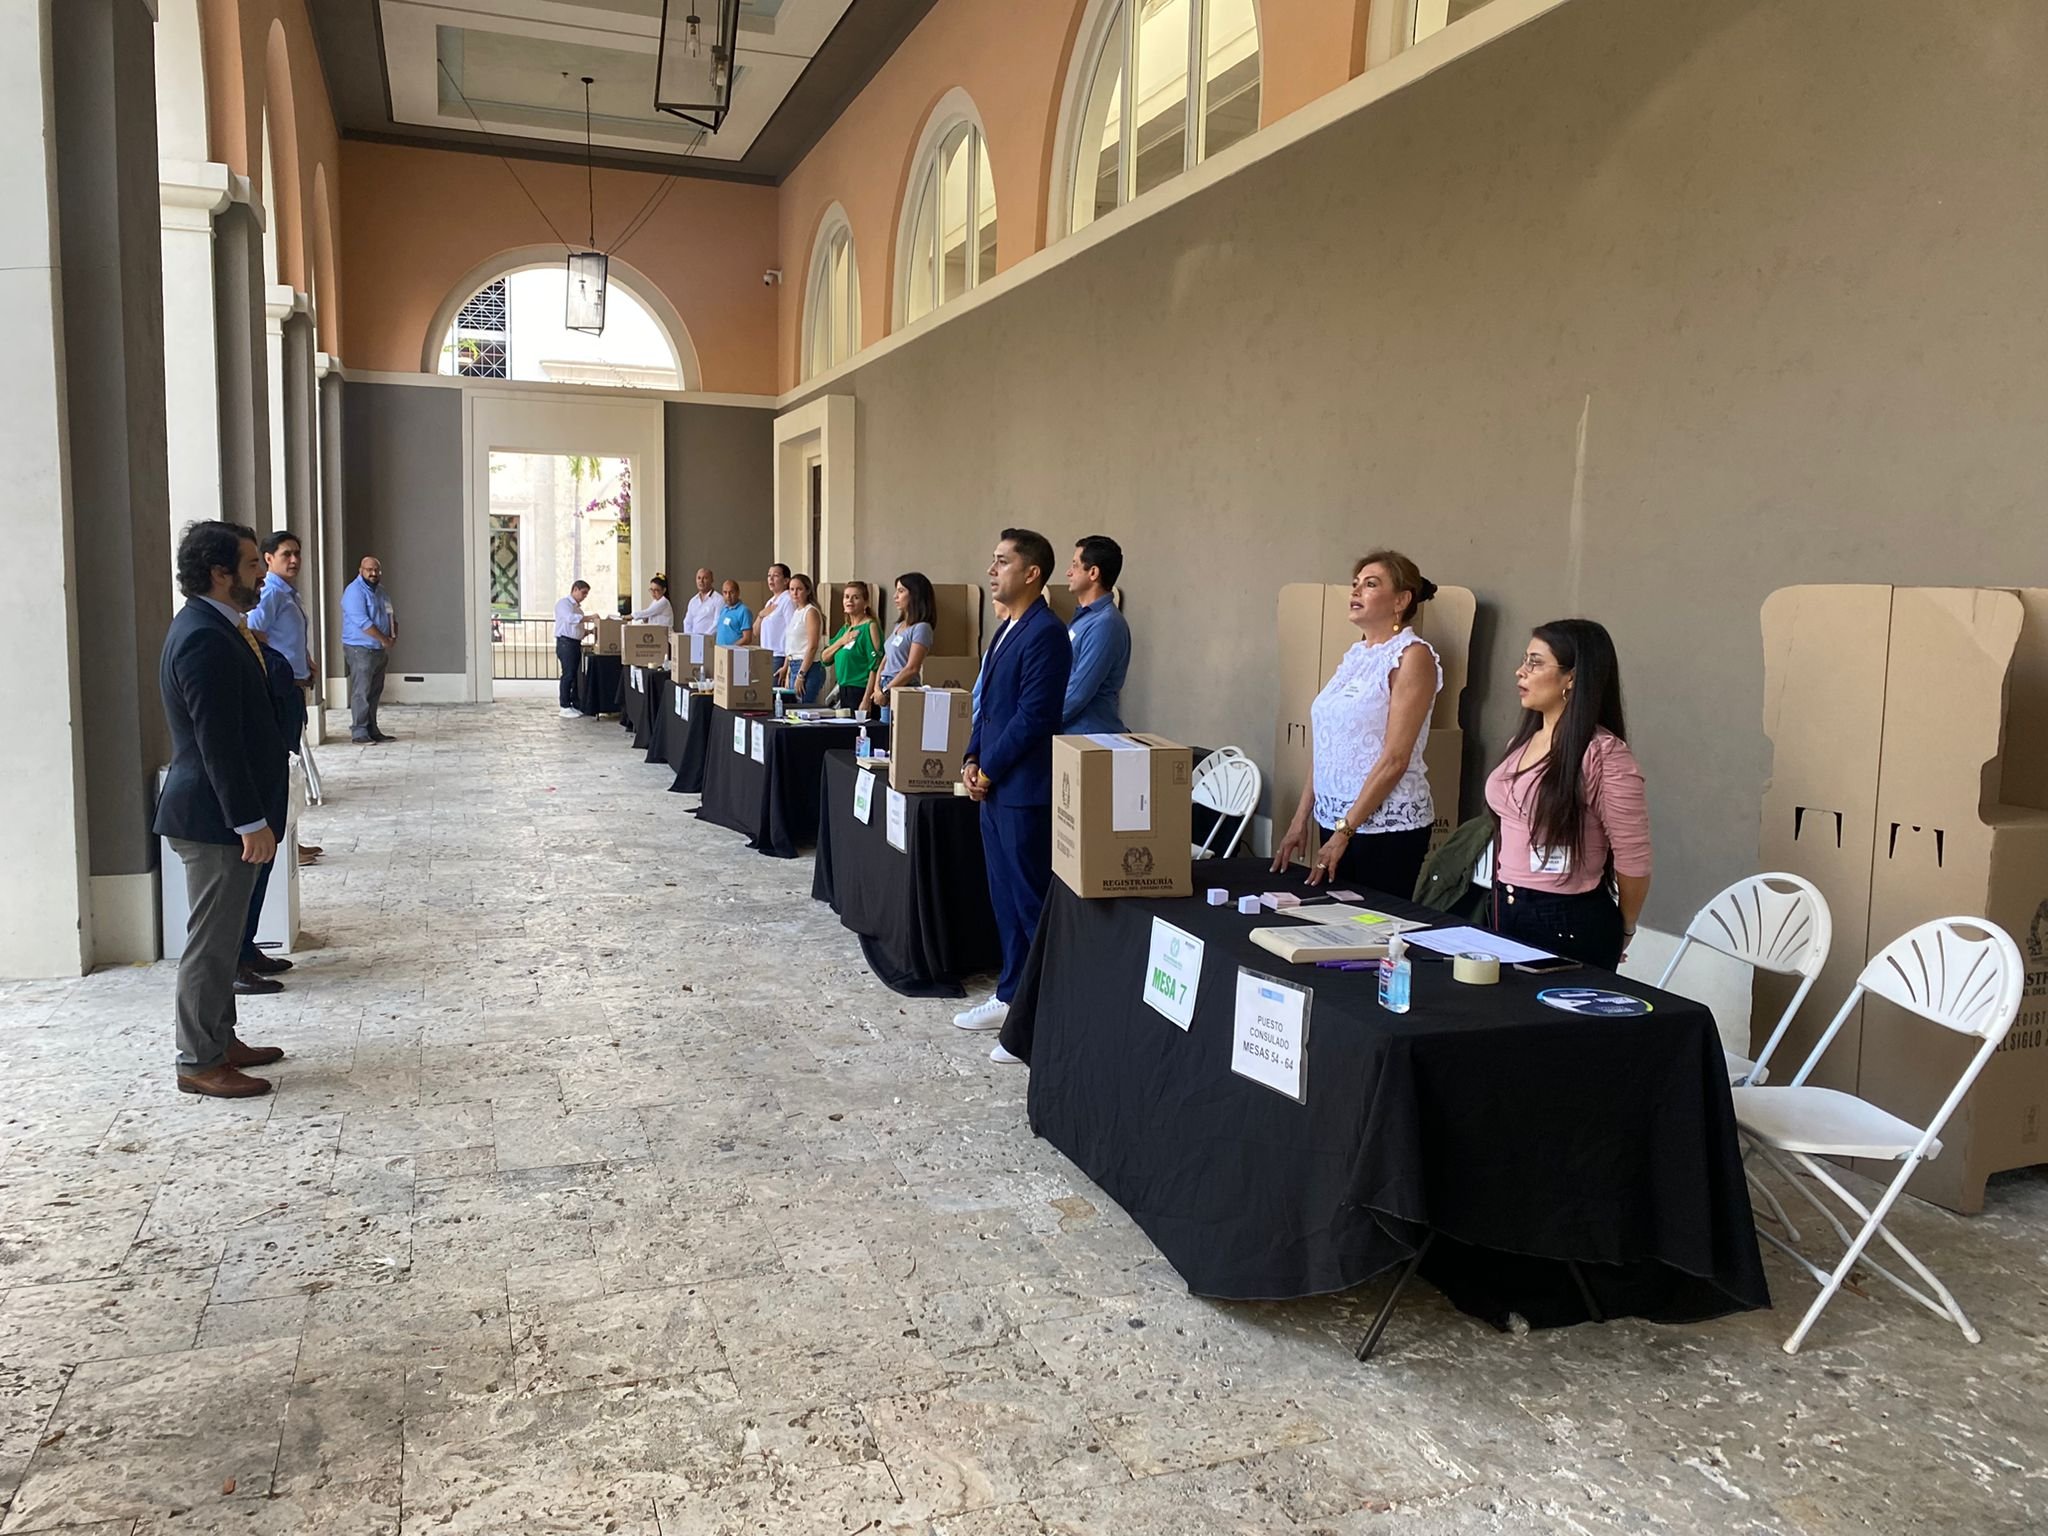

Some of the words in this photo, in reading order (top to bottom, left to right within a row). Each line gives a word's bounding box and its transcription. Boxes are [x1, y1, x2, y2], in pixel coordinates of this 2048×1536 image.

[1151, 966, 1176, 1001] MESA
[1178, 983, 1188, 1006] 7
[1257, 1015, 1284, 1033] PUESTO
[1249, 1026, 1290, 1050] CONSULADO
[2010, 1030, 2042, 1051] SIGLO
[1242, 1040, 1270, 1061] MESAS
[1271, 1051, 1279, 1065] 54
[1284, 1057, 1294, 1070] 64
